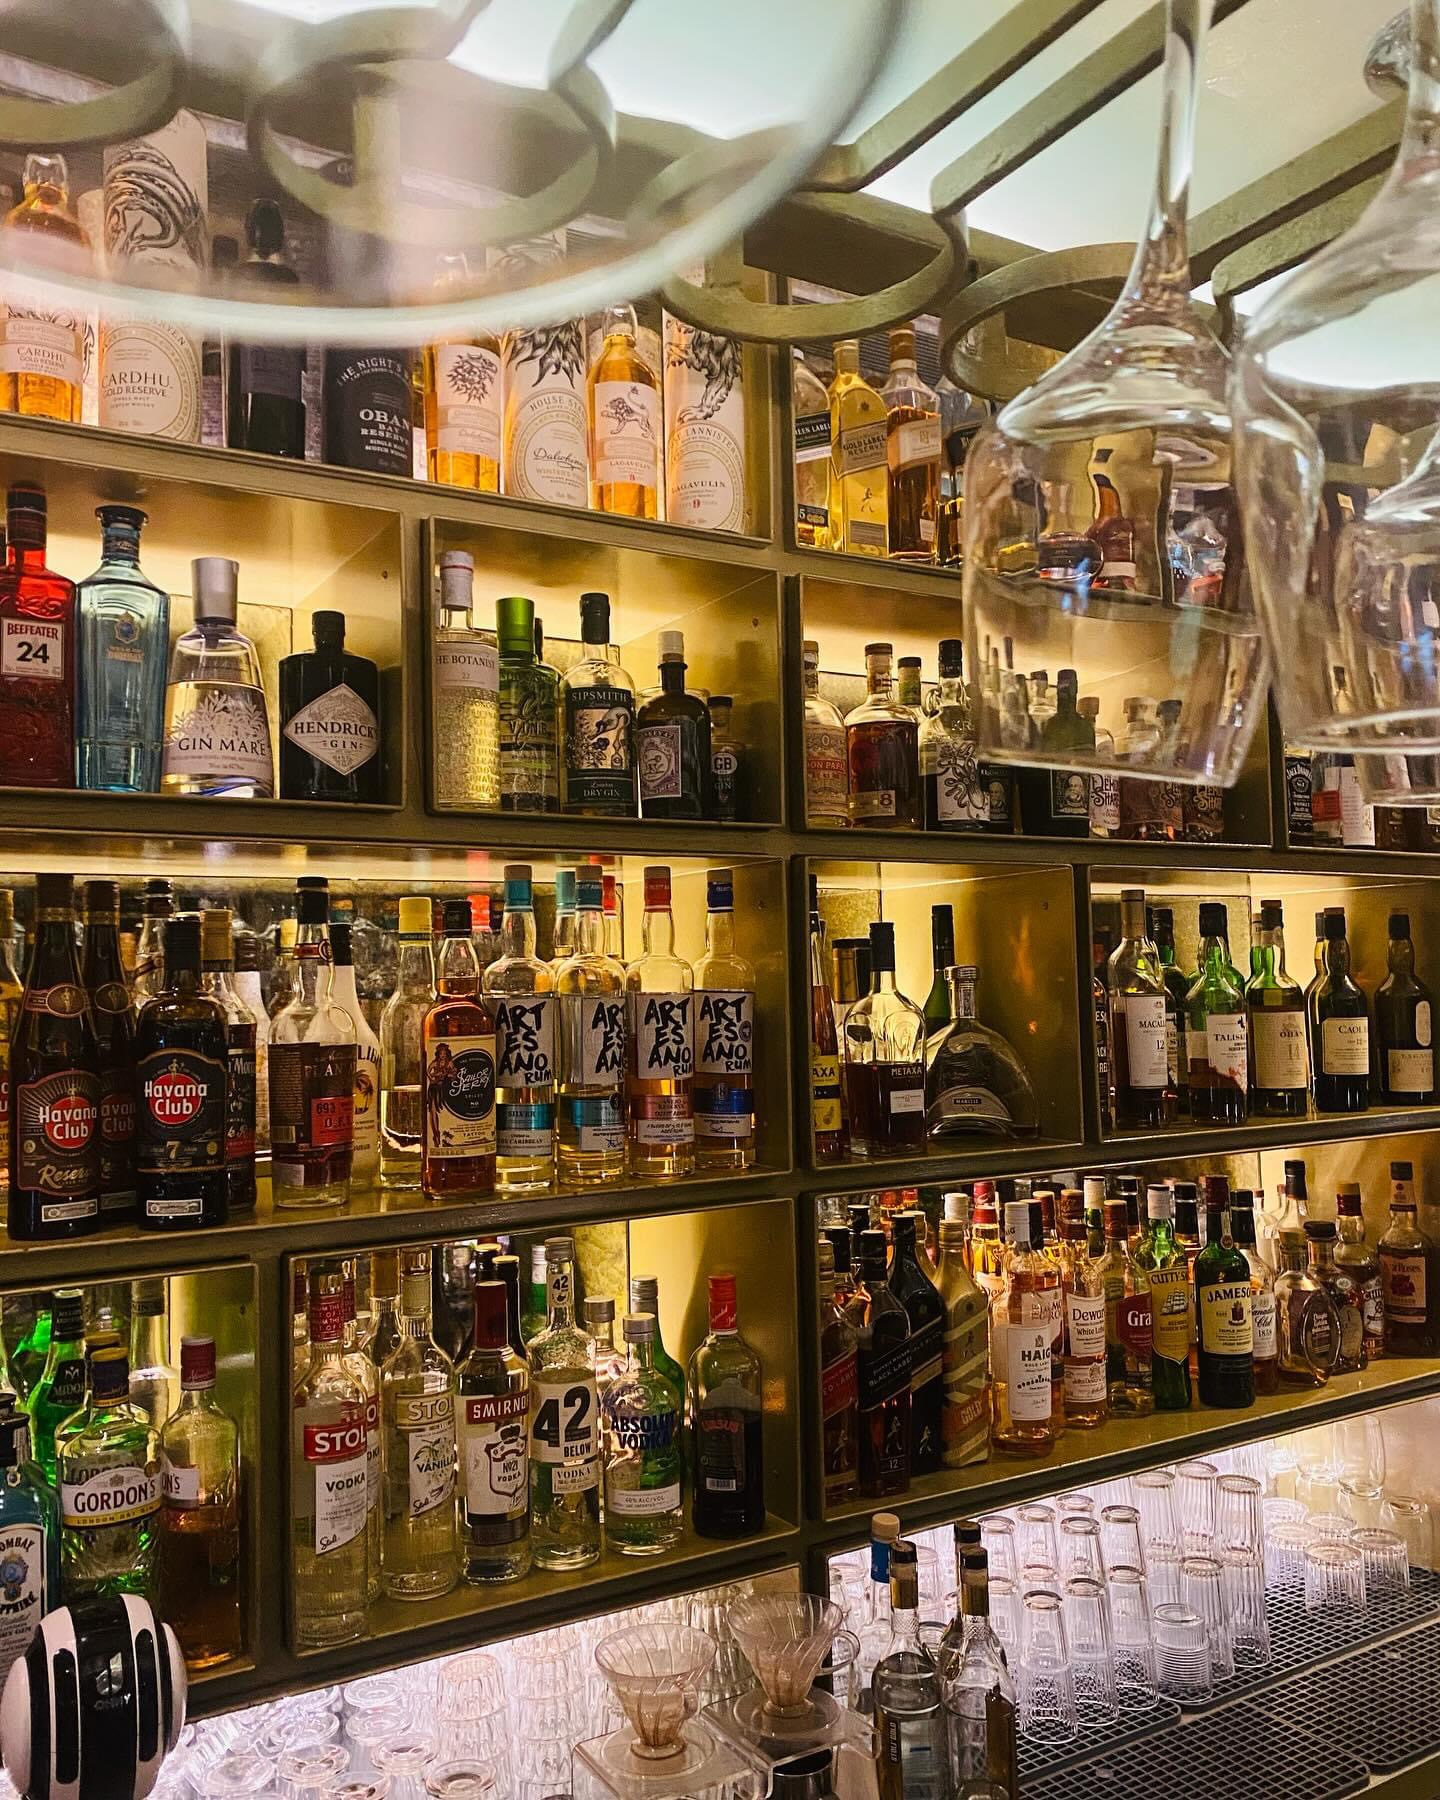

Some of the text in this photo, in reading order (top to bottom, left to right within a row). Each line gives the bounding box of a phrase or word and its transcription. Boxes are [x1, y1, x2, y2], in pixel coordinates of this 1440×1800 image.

[17, 347, 66, 363] CARDHU
[126, 385, 167, 397] RESERVE
[7, 622, 59, 641] BEEFEATER
[16, 641, 50, 664] 24
[571, 689, 629, 702] SIPSMITH
[178, 737, 267, 757] GIN MARE
[330, 739, 358, 750] GIN
[714, 755, 732, 770] GB
[880, 793, 893, 807] 8
[494, 1000, 546, 1032] ART
[644, 996, 690, 1028] ART
[700, 995, 748, 1025] ART
[504, 1028, 539, 1052] ES
[655, 1024, 685, 1048] ES
[708, 1021, 739, 1043] ES
[702, 1043, 748, 1064] ANO
[1156, 1039, 1165, 1051] 12
[498, 1050, 549, 1078] ANO
[648, 1046, 692, 1069] ANO
[891, 1066, 923, 1077] METAXA
[144, 1080, 208, 1099] Havana
[39, 1105, 97, 1124] Havana
[154, 1098, 193, 1116] Club
[53, 1121, 89, 1140] Club
[166, 1140, 181, 1160] 7
[553, 1275, 569, 1291] 42
[1127, 1310, 1152, 1327] Gra
[1076, 1327, 1094, 1336] White
[1022, 1347, 1051, 1362] HAIG
[532, 1384, 592, 1449] 42
[961, 1401, 984, 1425] GOLD
[563, 1444, 592, 1459] BELOW
[556, 1467, 592, 1480] VODKA
[889, 1459, 900, 1469] 12
[326, 1472, 366, 1493] VODKA
[497, 1471, 522, 1483] VODKA
[74, 1478, 157, 1514] GORDON'S
[77, 1515, 116, 1526] LONDON
